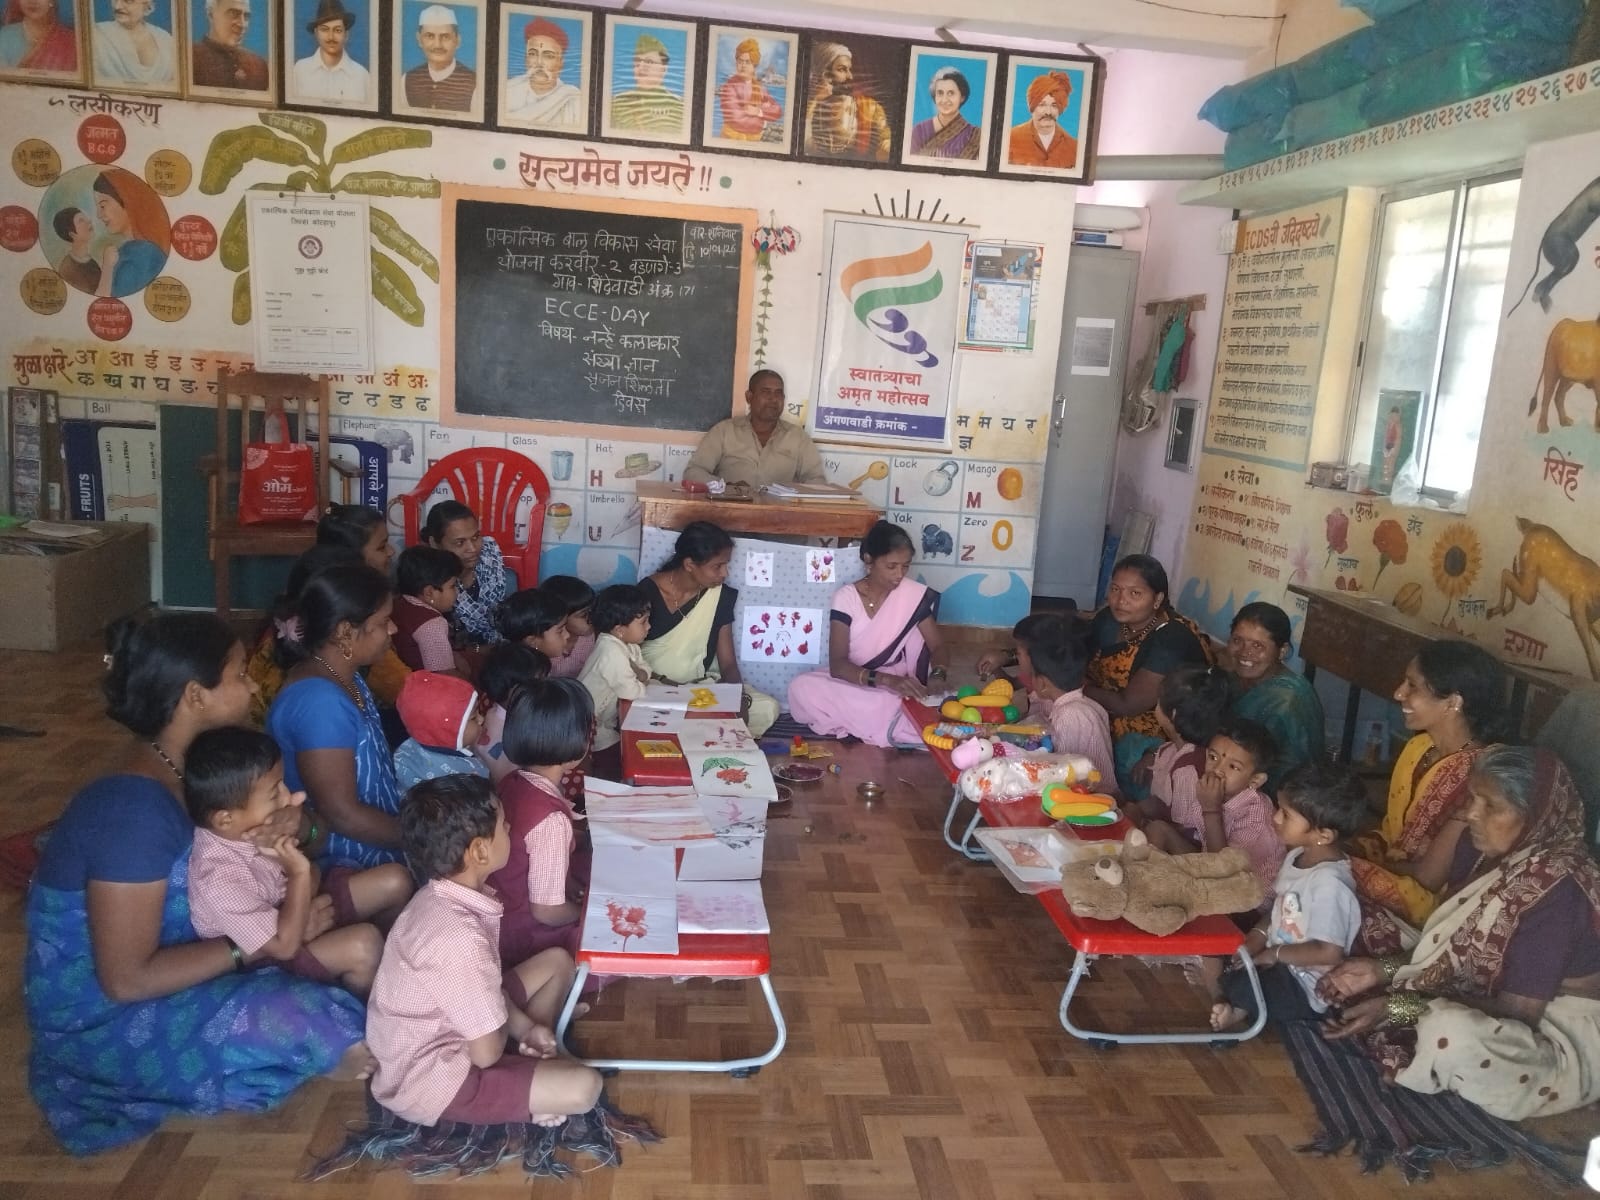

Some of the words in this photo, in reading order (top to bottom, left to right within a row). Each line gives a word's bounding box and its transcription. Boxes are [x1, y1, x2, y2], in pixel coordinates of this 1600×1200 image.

[1423, 113, 1437, 131] २०
[1438, 108, 1454, 127] २१
[1456, 104, 1472, 122] २२
[1473, 98, 1491, 118] २३
[1492, 92, 1513, 112] २४
[1516, 85, 1537, 106] २५
[1540, 78, 1561, 101] २६
[1564, 71, 1587, 93] २७
[519, 147, 621, 188] सत्यमेव
[627, 154, 694, 191] जयते
[486, 226, 555, 248] एकात्मिक
[563, 231, 588, 249] बाल
[594, 229, 640, 253] विकास
[645, 233, 677, 253] सेवा
[497, 249, 545, 273] योजना
[619, 335, 681, 358] कलाकार
[75, 350, 98, 365] अ
[110, 351, 134, 367] आ
[145, 350, 159, 370] ई
[384, 369, 400, 387] अं
[408, 374, 429, 389] अः
[849, 365, 922, 387] स्वातंत्र्याचा
[77, 371, 95, 386] क
[104, 373, 123, 389] ख
[130, 375, 146, 391] ग
[153, 377, 170, 392] घ
[336, 390, 354, 405] ट
[364, 392, 381, 408] ठ
[389, 394, 406, 409] ड
[415, 396, 430, 412] ढ
[837, 386, 872, 406] अमृत
[877, 386, 930, 406] महोत्सव
[92, 402, 110, 414] Ball
[823, 411, 872, 429] अंगणवाडी
[875, 417, 908, 431] क्रमांक
[1001, 417, 1016, 431] य
[1024, 419, 1038, 434] र
[430, 430, 449, 440] Fan
[512, 436, 538, 446] Glass
[595, 443, 613, 454] Hat
[825, 458, 840, 473] Key
[894, 459, 917, 469] Lock
[968, 464, 997, 478] Mango
[368, 456, 384, 492] आपले
[590, 470, 603, 486] H
[1544, 446, 1584, 502] सिंह
[79, 473, 92, 512] FRUITS
[520, 495, 533, 505] op
[590, 493, 625, 504] Umbrella
[895, 487, 905, 505] L
[966, 492, 982, 509] M
[893, 513, 913, 524] Yak
[963, 517, 988, 528] Zero
[589, 526, 602, 541] U
[960, 545, 977, 562] Z
